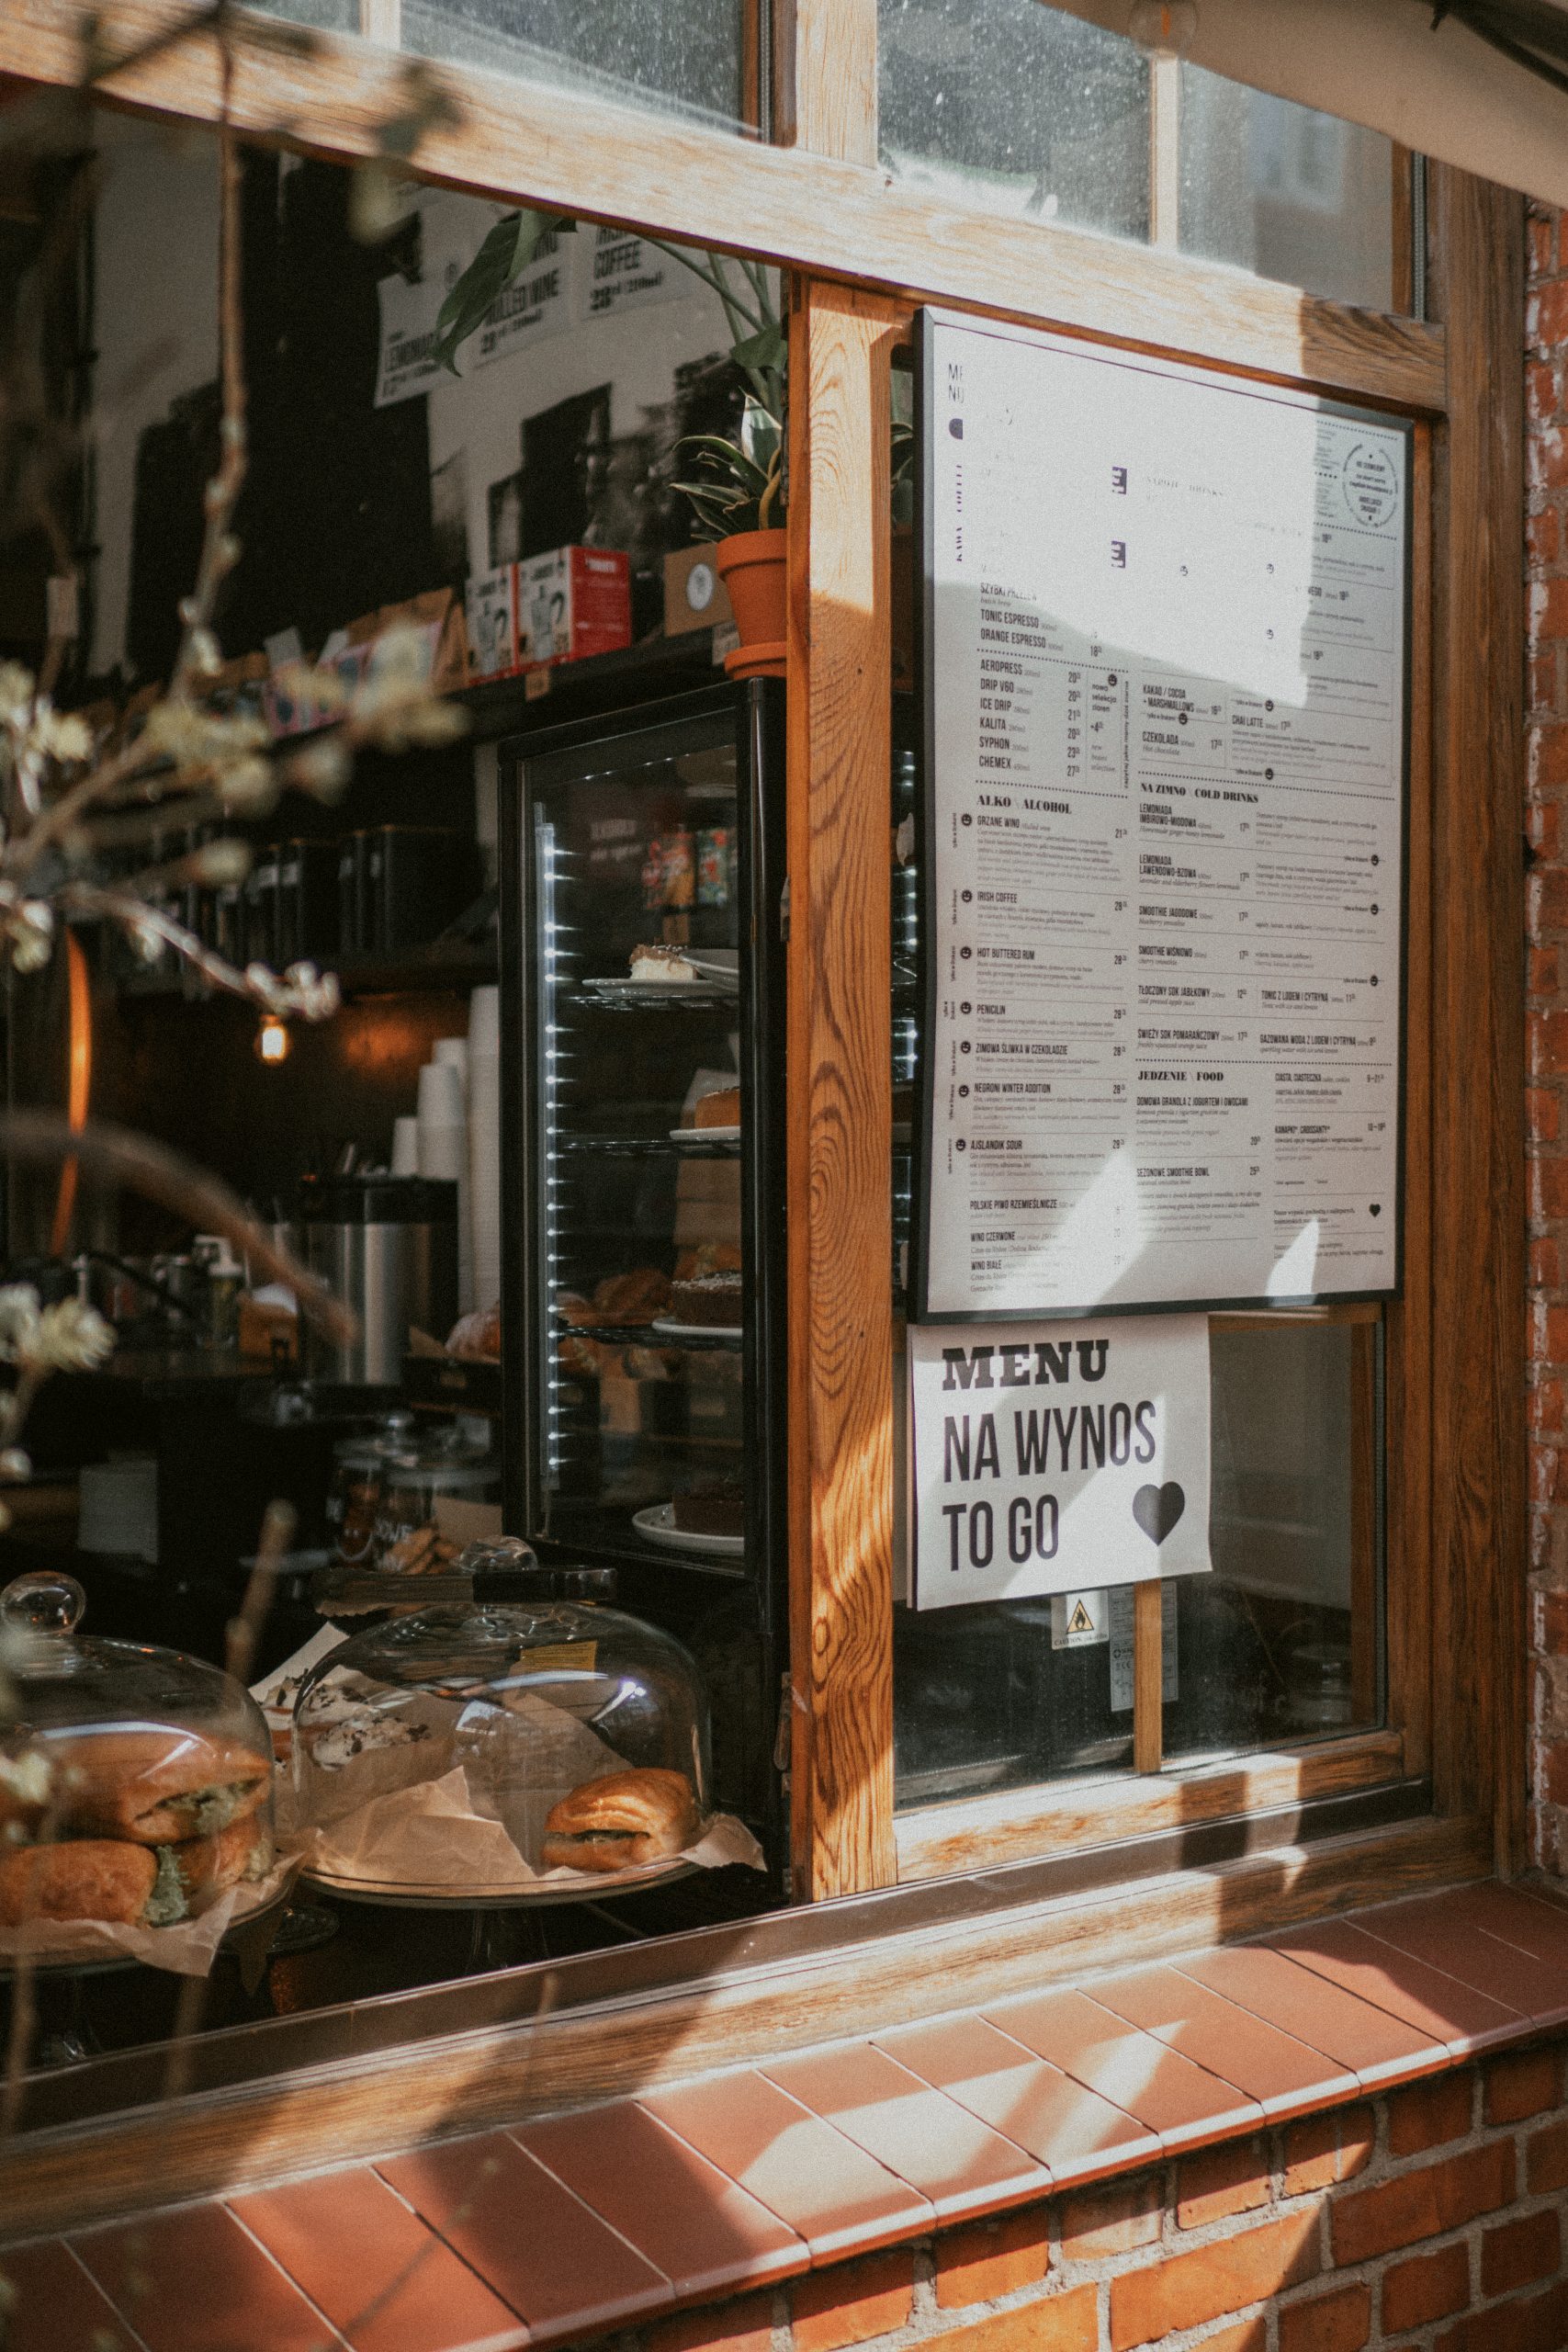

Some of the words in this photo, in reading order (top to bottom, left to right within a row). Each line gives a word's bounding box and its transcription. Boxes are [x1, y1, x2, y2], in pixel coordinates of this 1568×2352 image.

[593, 241, 641, 279] COFFEE
[980, 609, 1002, 623] TONIC
[1004, 613, 1039, 628] ESPRESSO
[980, 628, 1009, 642] ORANGE
[1012, 633, 1045, 648] ESPRESSO
[981, 660, 1022, 675] AEROPRESS
[980, 678, 998, 690] DRIP
[1000, 681, 1014, 693] V60
[1143, 684, 1162, 695] KAKAO
[1168, 688, 1186, 698] COCOA
[980, 698, 992, 709] ICE
[994, 699, 1011, 711] DRIP
[1148, 697, 1194, 712] MARSHMALLOWS
[979, 717, 1006, 730] KALITA
[1232, 715, 1246, 726] CHAI
[1247, 718, 1264, 728] LATTE
[979, 736, 1010, 750] SYPHON
[1143, 731, 1179, 745] CZEKOLADA
[979, 755, 1011, 769] CHEMEX
[1141, 783, 1153, 793] NA
[1156, 785, 1186, 796] ZIMNO
[1195, 788, 1220, 798] COLD
[1224, 790, 1258, 803] DRINKS
[976, 795, 1011, 808] ALKO
[1021, 798, 1072, 815] ALCOHOL
[1139, 803, 1172, 814] LEMONIADA
[977, 816, 1002, 827] GRZANE
[1004, 818, 1020, 829] WINO
[1139, 814, 1197, 828] IMBIROWO-MIODOWA
[1139, 854, 1171, 865] LEMONIADA
[977, 892, 994, 901] IRISH
[996, 893, 1018, 903] COFFEE
[1139, 906, 1167, 916] SMOOTHIE
[1168, 908, 1197, 919] JAGODOWE
[977, 948, 989, 958] HOT
[991, 949, 1021, 959] BUTTERED
[1022, 950, 1035, 959] RUM
[1138, 945, 1165, 956] SMOOTHIE
[1138, 986, 1167, 995] TŁOCZONY
[1168, 988, 1179, 996] SOK
[1181, 988, 1210, 998] JABŁKOWY
[1261, 990, 1277, 1001] TONIC
[1282, 991, 1300, 1001] LODEM
[976, 1004, 1006, 1015] PENICILIN
[1138, 1028, 1159, 1038] ŚWIEŻY
[1160, 1030, 1171, 1039] SOK
[1173, 1029, 1220, 1041] POMARAŃCZOWY
[1260, 1035, 1289, 1044] GAZOWANA
[1291, 1035, 1305, 1044] WODA
[1312, 1035, 1329, 1045] LODEM
[976, 1043, 1000, 1054] ZIMOWA
[1001, 1043, 1023, 1054] ŚLIWKA
[1024, 1045, 1030, 1054] W
[1031, 1045, 1068, 1056] CZEKOLADZIE
[1138, 1070, 1187, 1081] JEDZENIE
[1197, 1071, 1224, 1081] FOOD
[975, 1083, 1000, 1092] NEGRONI
[1002, 1084, 1024, 1093] WINTER
[1025, 1084, 1051, 1093] ADDITION
[1136, 1097, 1160, 1106] DOMOWA
[1162, 1097, 1187, 1106] GRANOLA
[1224, 1098, 1248, 1106] OWOCAMI
[971, 1140, 1004, 1150] AJSLANDIK
[1006, 1140, 1022, 1150] SOUR
[1136, 1168, 1166, 1178] SEZONOWE
[1167, 1168, 1194, 1177] SMOOTHIE
[1194, 1168, 1210, 1177] BOWL
[970, 1200, 992, 1210] POLSKIE
[994, 1200, 1009, 1209] PIWO
[1010, 1199, 1057, 1209] RZEMIEŚLNICZE
[971, 1233, 984, 1242] WINO
[986, 1231, 1015, 1241] CZERWONE
[971, 1261, 985, 1271] WINO
[987, 1260, 1002, 1270] BIAŁE
[942, 1339, 1110, 1391] MENU
[942, 1412, 1001, 1484] NA
[1014, 1400, 1156, 1476] WYNOS
[942, 1500, 994, 1572] TO
[1008, 1493, 1059, 1564] GO
